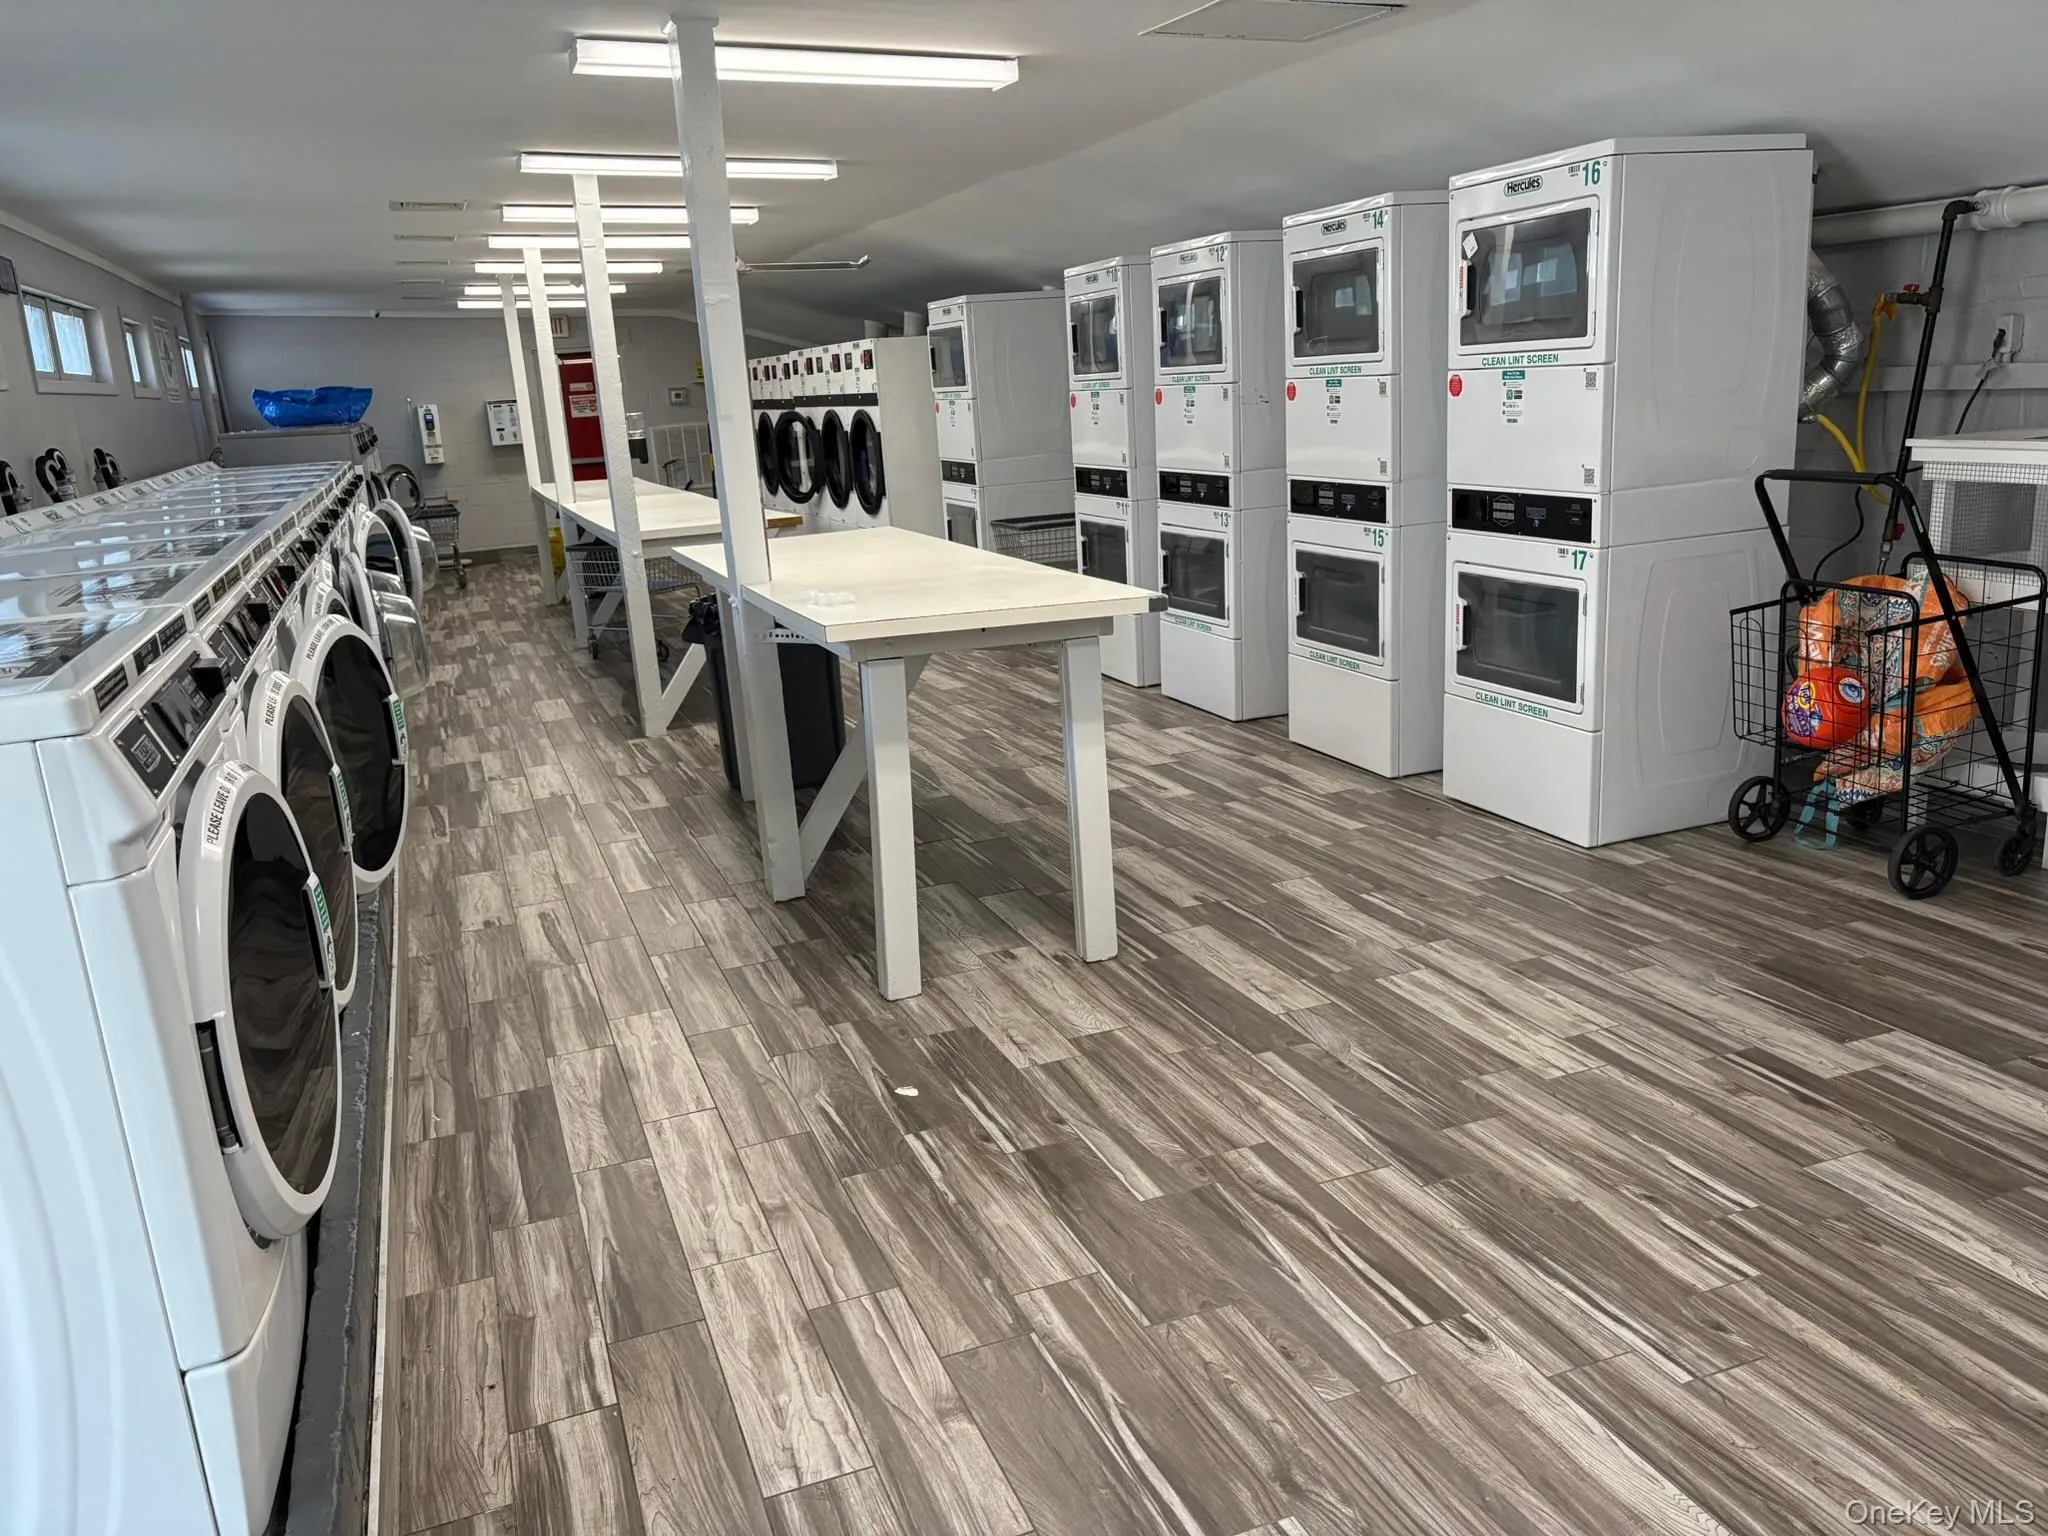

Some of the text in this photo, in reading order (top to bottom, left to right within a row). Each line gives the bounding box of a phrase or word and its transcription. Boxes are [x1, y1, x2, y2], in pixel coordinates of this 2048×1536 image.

[1582, 160, 1601, 186] 16
[1507, 177, 1541, 195] Hercules
[1372, 210, 1384, 229] 14
[1216, 246, 1225, 262] 12
[1481, 353, 1559, 367] CLEAN LINT SCREEN
[1220, 511, 1229, 528] 13
[1372, 528, 1384, 547] 15
[1571, 549, 1588, 570] 17
[1475, 691, 1549, 718] CLEAN LINT SCREEN
[207, 811, 221, 845] PLEASE
[214, 790, 229, 814] LEAVE
